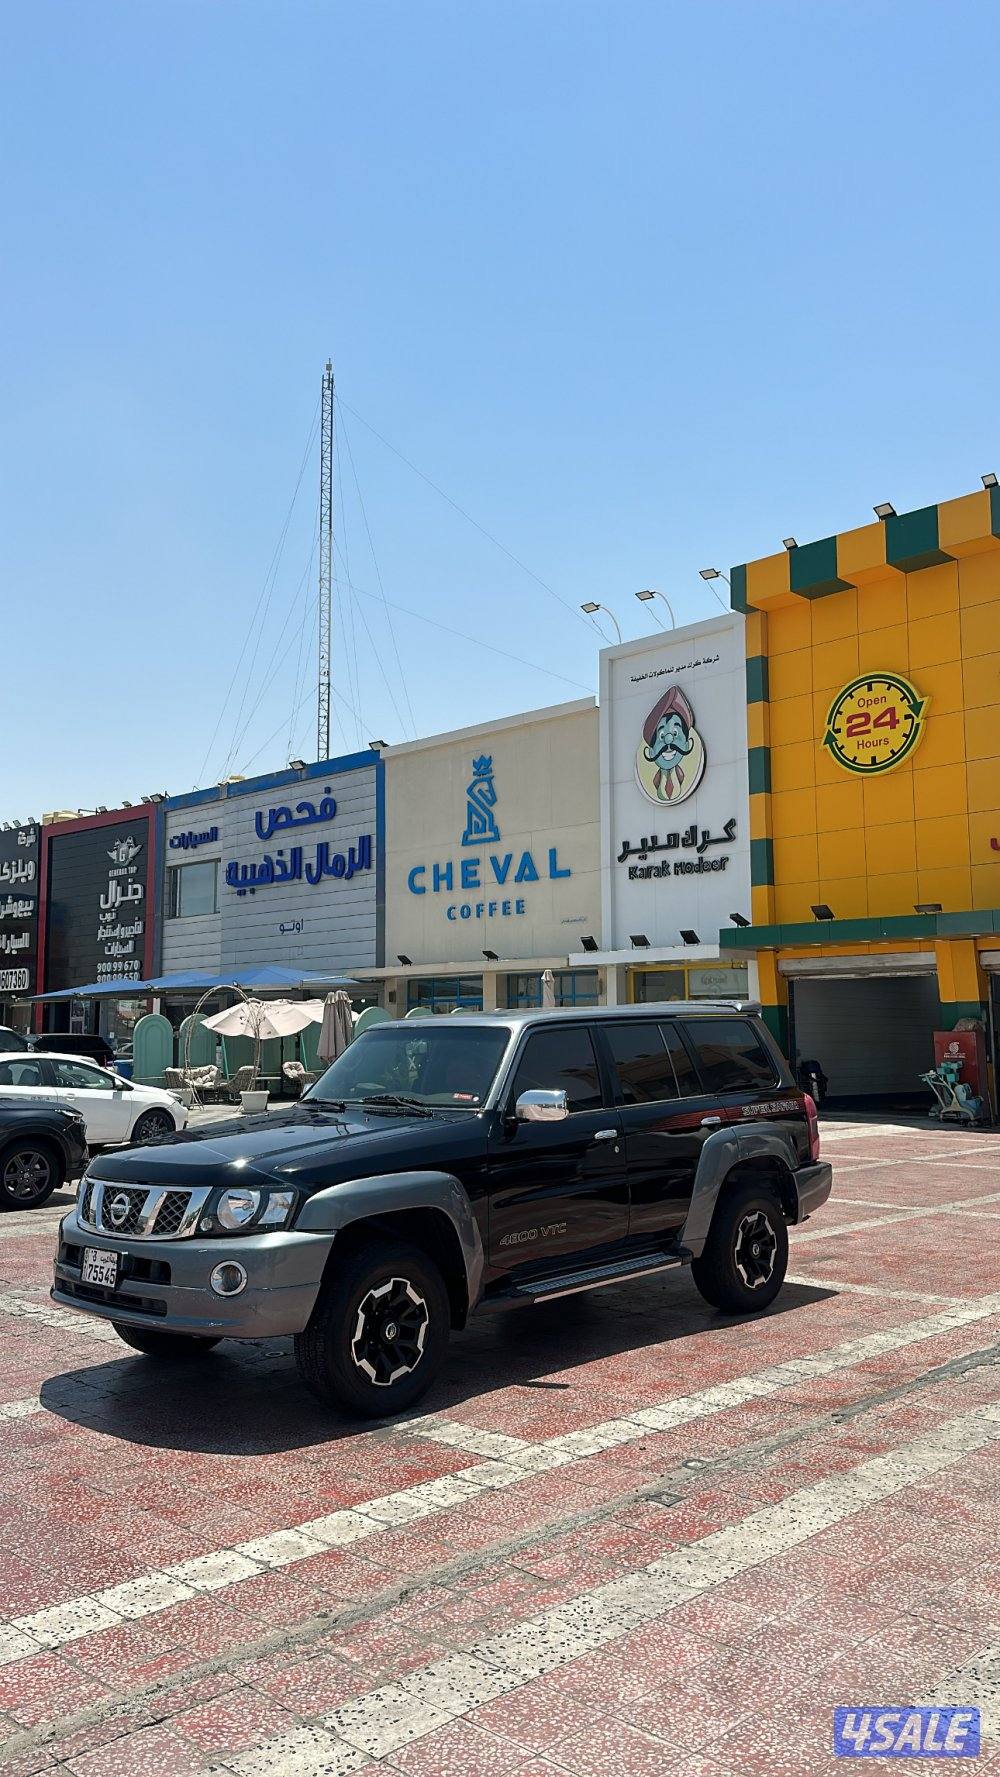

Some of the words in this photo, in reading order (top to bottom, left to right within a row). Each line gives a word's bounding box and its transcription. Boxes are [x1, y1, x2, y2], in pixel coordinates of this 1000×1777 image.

[857, 696, 887, 708] Open
[846, 706, 900, 738] 24
[857, 737, 890, 750] Hours
[255, 786, 337, 841] فحص
[169, 826, 219, 850] السيارات
[681, 818, 737, 854] كرك
[226, 846, 303, 896] الذهبية
[305, 834, 372, 885] الرمال
[407, 848, 571, 895] CHEVAL
[628, 860, 671, 880] Karak
[673, 856, 730, 876] Modeer
[100, 878, 144, 909] جنرال
[446, 899, 526, 921] COFFEE
[0, 933, 30, 954] السيارا
[499, 1228, 538, 1246] 4800
[540, 1222, 567, 1237] VTC
[87, 1264, 116, 1285] 75545
